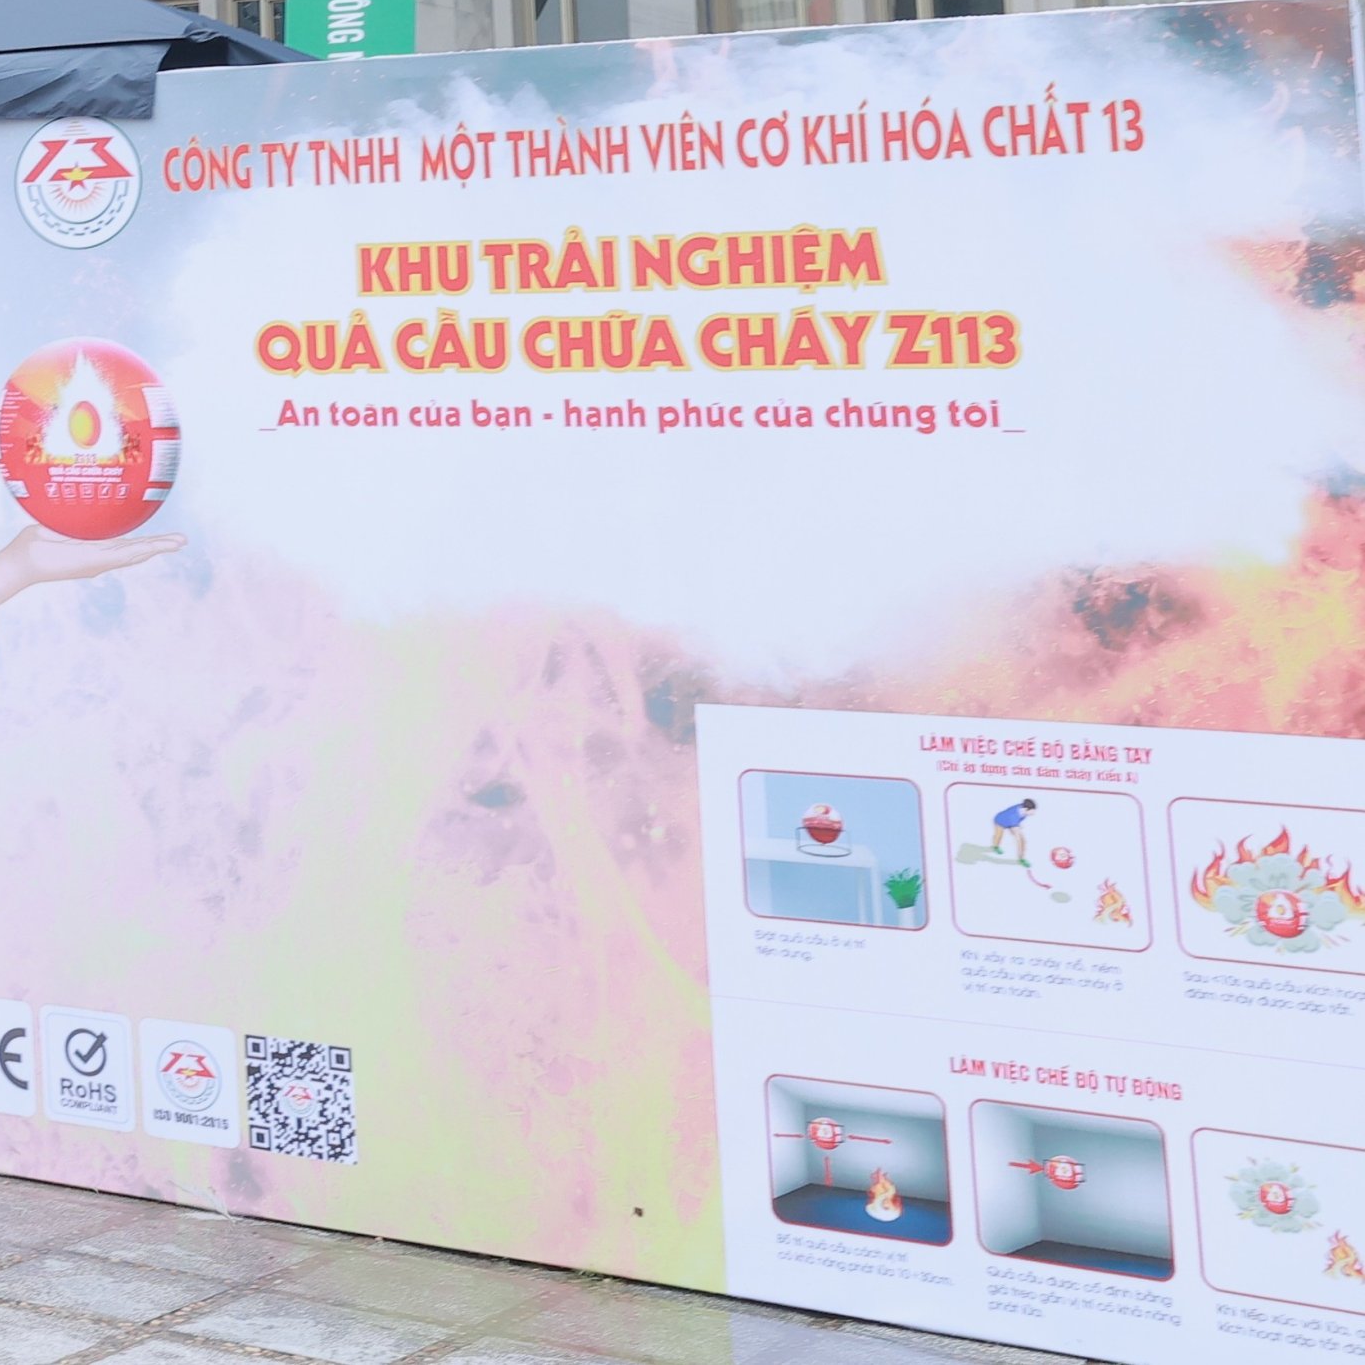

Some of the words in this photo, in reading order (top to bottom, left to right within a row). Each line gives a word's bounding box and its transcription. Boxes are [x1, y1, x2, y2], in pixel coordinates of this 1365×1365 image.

[163, 135, 253, 193] CÔNG
[262, 143, 296, 189] TY
[308, 137, 401, 187] TNHH
[420, 121, 495, 189] MỘT
[508, 116, 631, 178] THÀNH
[639, 110, 725, 172] VIÊN
[736, 109, 790, 169] CƠ
[801, 100, 870, 166] KHÍ
[880, 96, 973, 162] HÓA
[982, 81, 1093, 158] CHẤT
[1101, 98, 1146, 153] 13
[356, 241, 473, 296] KHU
[481, 224, 618, 295] TRẢI
[629, 223, 888, 295] NGHIỆM
[254, 309, 386, 377] QUẢ
[393, 307, 510, 374] CẦU
[521, 309, 692, 374] CHỮA
[699, 306, 872, 370] CHÁY
[884, 309, 1022, 371] Z113
[329, 401, 399, 429] toàn
[408, 398, 462, 429] của
[470, 399, 534, 433] bạn
[564, 399, 647, 433] hạnh
[657, 398, 745, 435] phúc
[753, 395, 814, 429] của
[824, 395, 938, 435] chúng
[920, 732, 956, 753] LÀM
[960, 735, 998, 758] VIỆC
[1003, 737, 1036, 757] CHẾ
[1071, 738, 1118, 763] BẰNG
[1124, 747, 1154, 765] TAY
[60, 1076, 118, 1104] RoHS
[950, 1053, 987, 1077] LÀM
[992, 1060, 1030, 1085] VIỆC
[1036, 1064, 1070, 1087] CHẾ
[1104, 1074, 1128, 1098] TỰ
[60, 1096, 119, 1115] COMPLIANT
